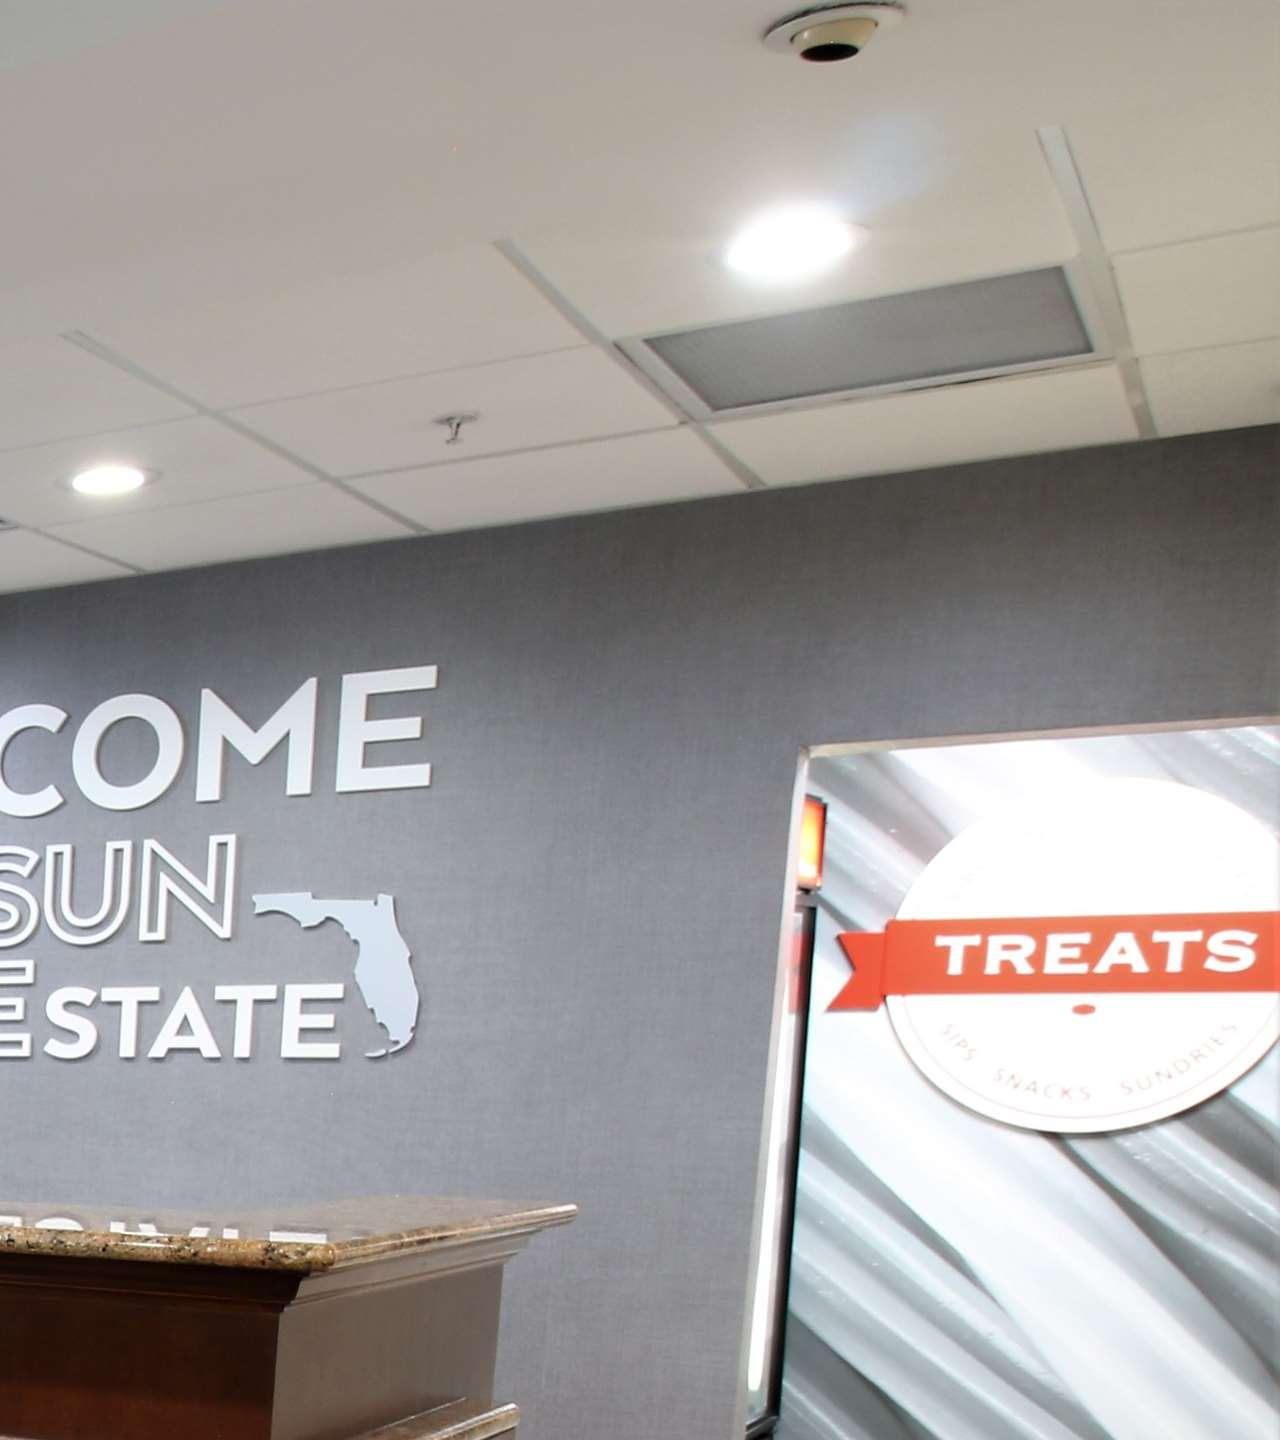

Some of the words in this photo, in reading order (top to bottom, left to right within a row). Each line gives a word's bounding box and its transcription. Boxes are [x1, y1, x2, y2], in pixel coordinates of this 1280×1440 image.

[934, 929, 1260, 976] TREATS
[43, 983, 345, 1059] STATE
[941, 1022, 978, 1062] SIPS
[992, 1067, 1092, 1100] SNACKS
[1120, 1021, 1239, 1097] SUNDRIES
